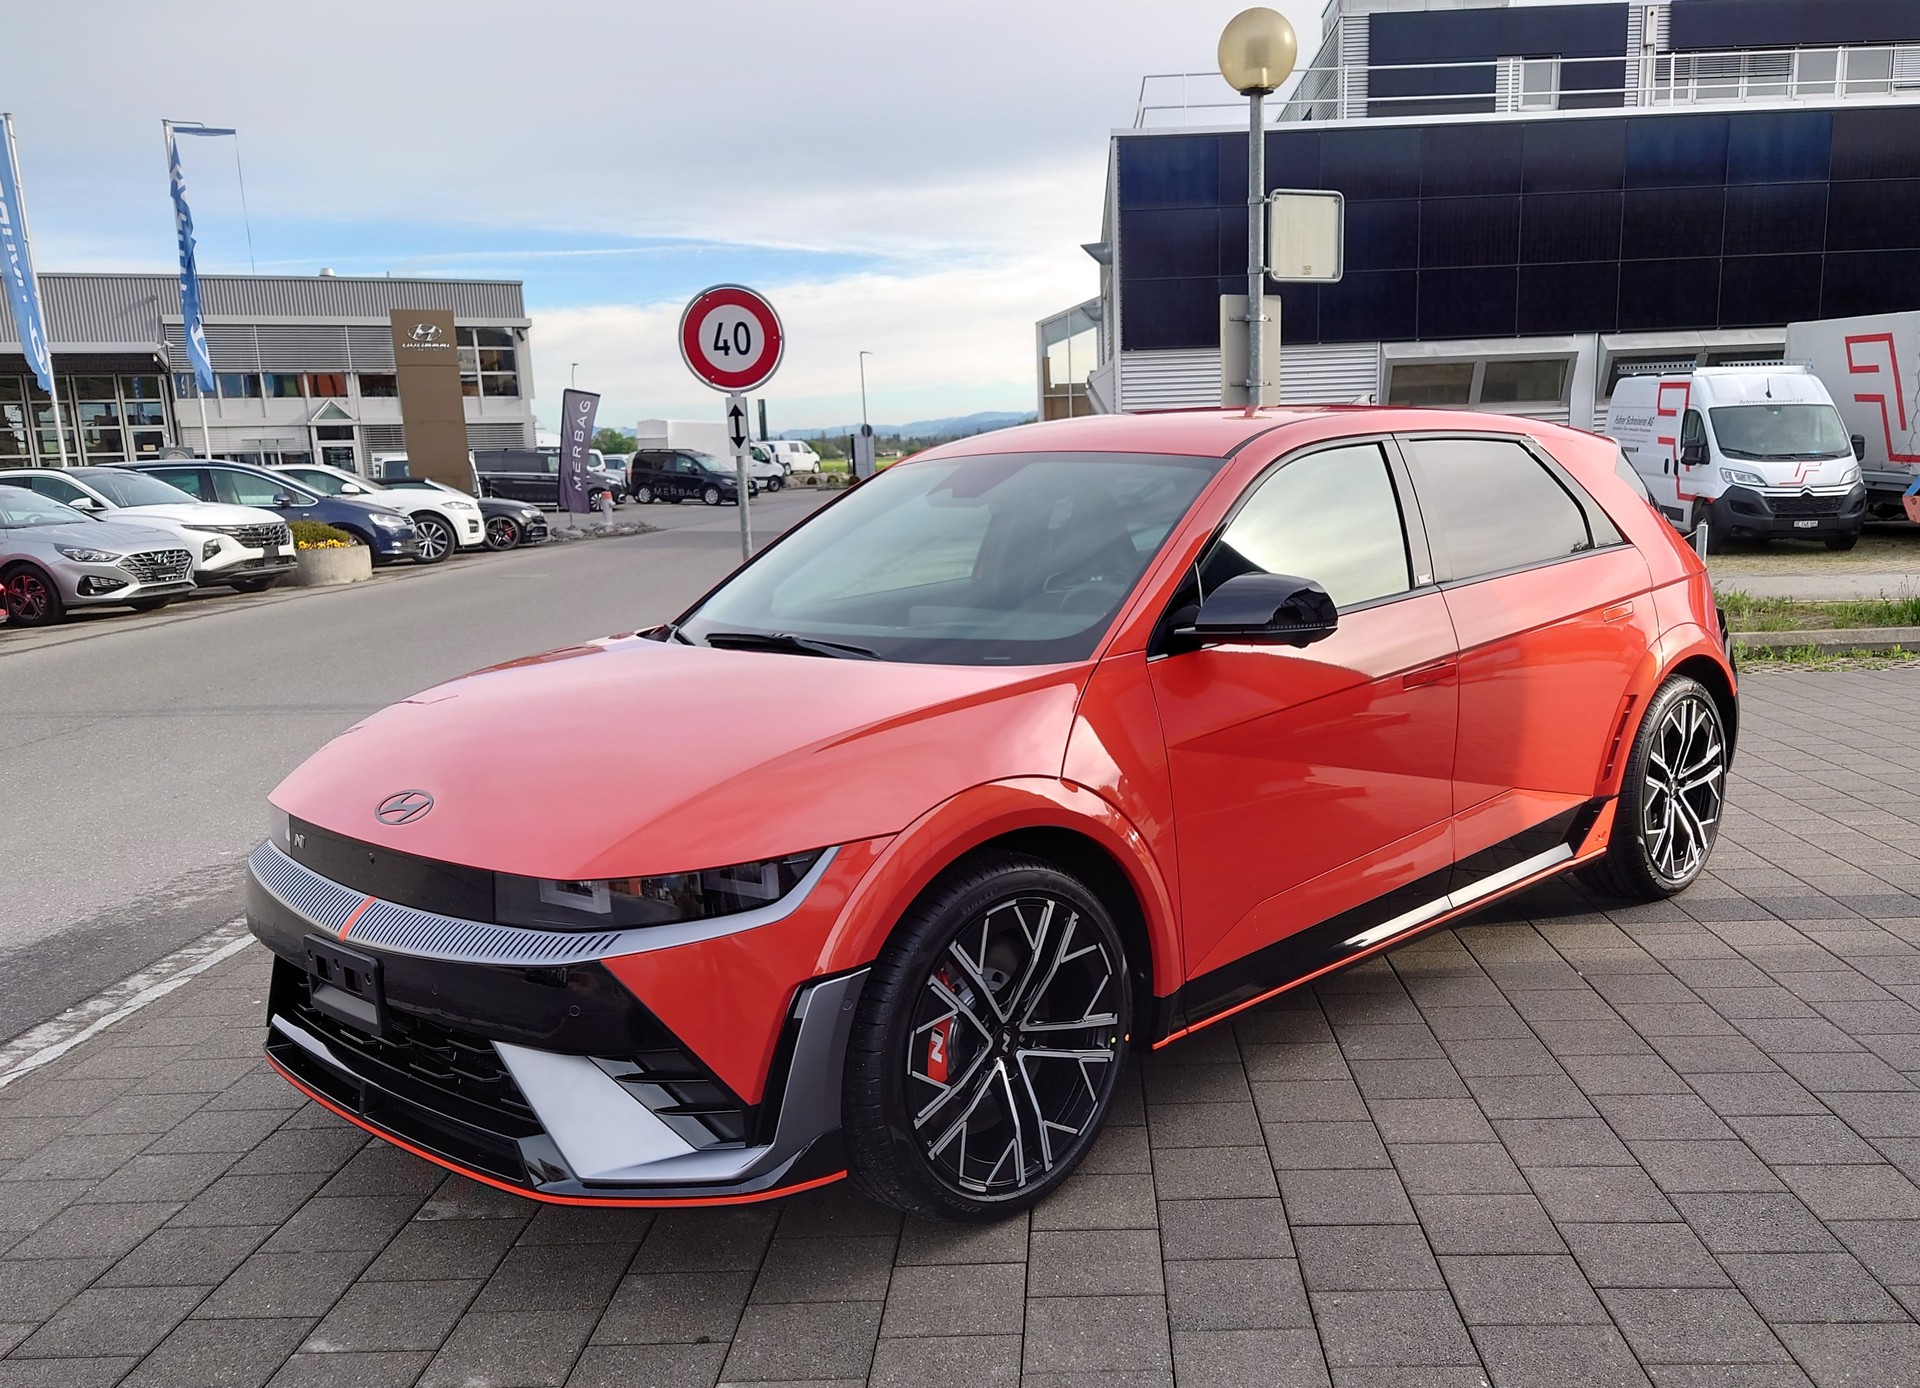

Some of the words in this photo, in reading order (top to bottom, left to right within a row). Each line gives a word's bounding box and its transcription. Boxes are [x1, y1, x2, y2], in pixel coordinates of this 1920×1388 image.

[713, 321, 751, 356] 40
[572, 400, 591, 491] MERBAG
[653, 487, 700, 498] MERBAG
